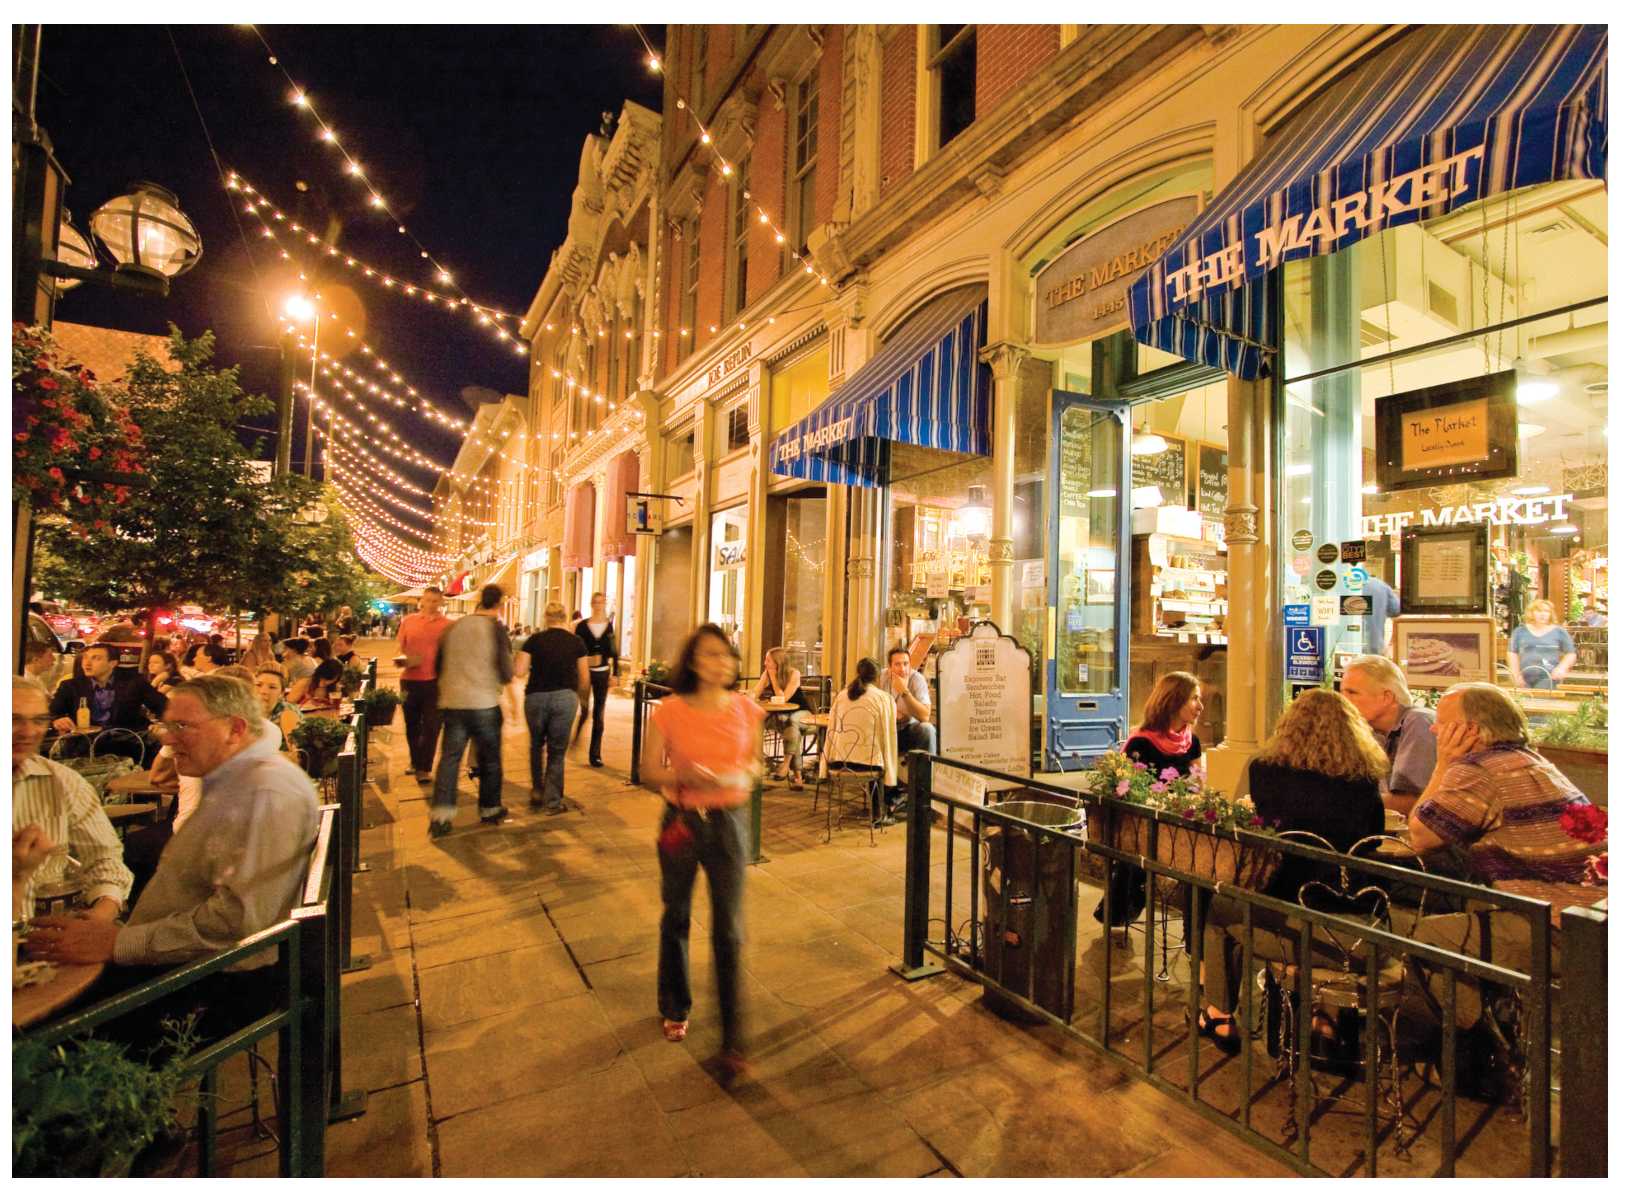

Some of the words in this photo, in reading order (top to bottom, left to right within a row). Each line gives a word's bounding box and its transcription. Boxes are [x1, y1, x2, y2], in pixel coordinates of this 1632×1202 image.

[1166, 241, 1244, 302] THE
[1254, 144, 1485, 267] MARKET
[1046, 273, 1085, 310] THE
[779, 437, 801, 462] THE
[802, 417, 852, 453] MARKET
[1410, 422, 1430, 436] The
[1362, 511, 1414, 537] THE
[1421, 494, 1574, 527] MARKET
